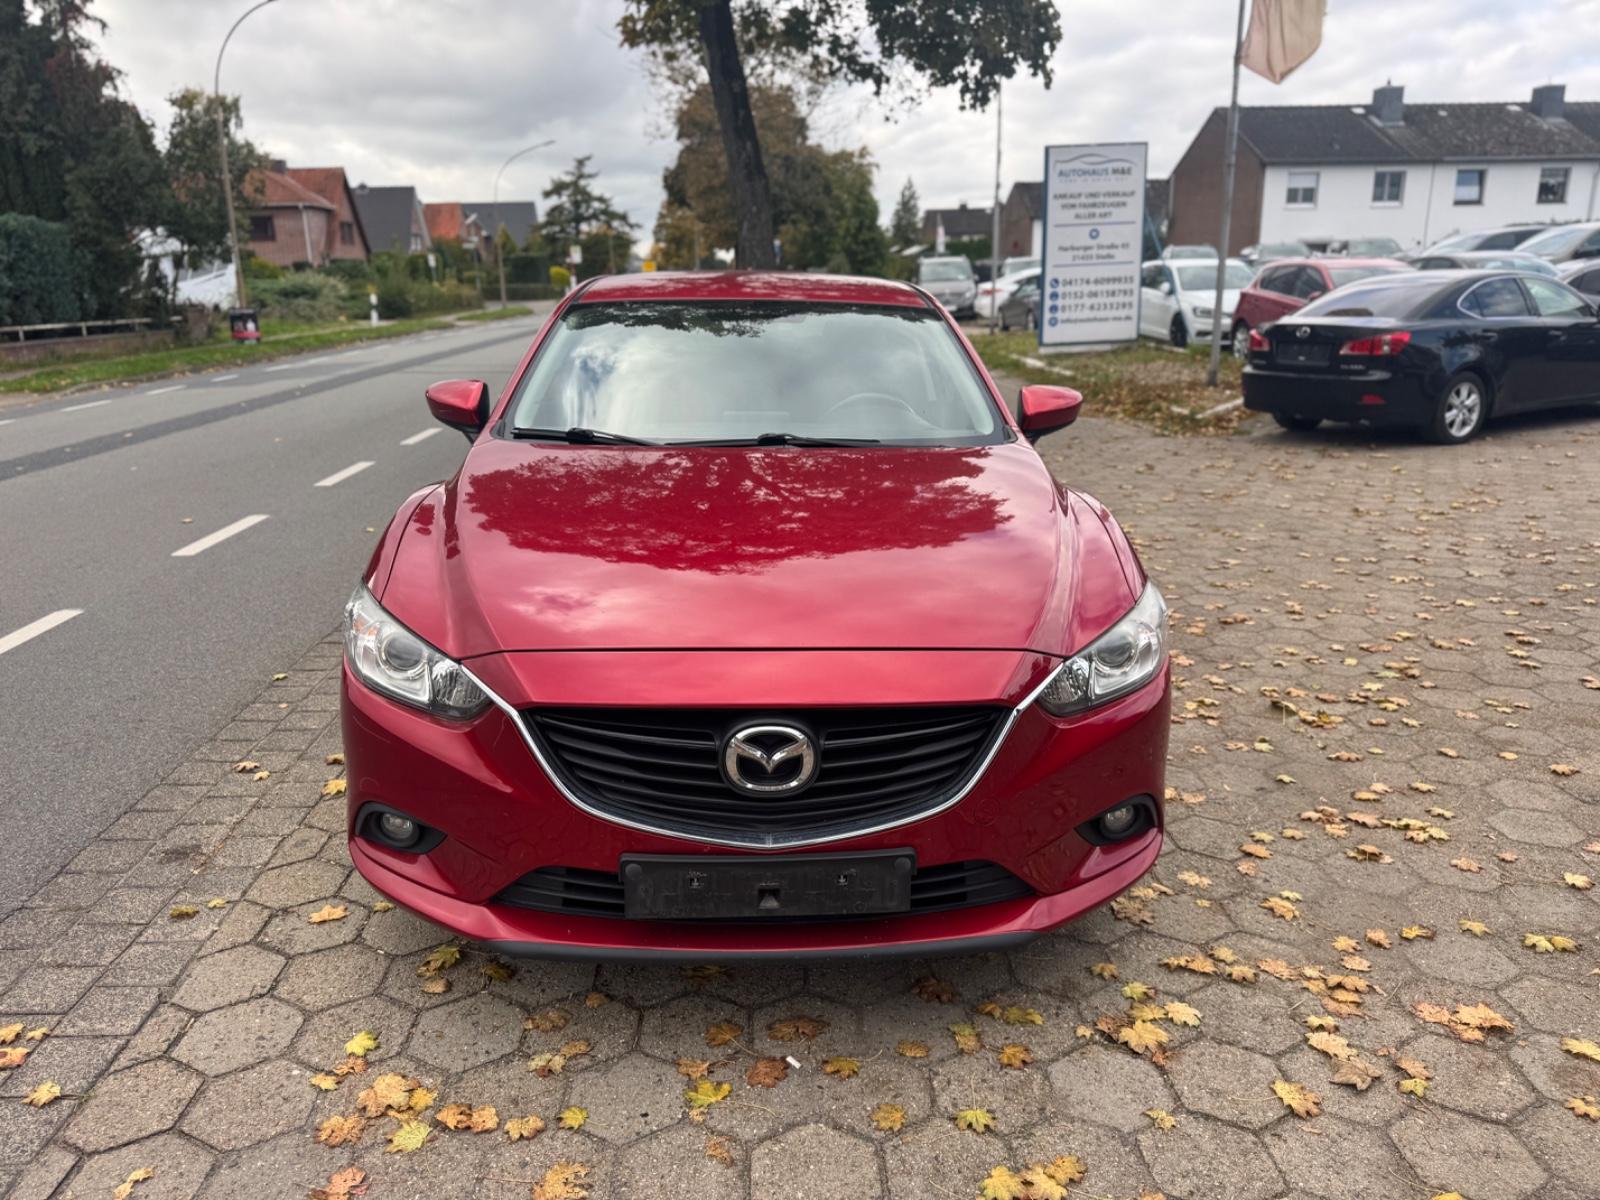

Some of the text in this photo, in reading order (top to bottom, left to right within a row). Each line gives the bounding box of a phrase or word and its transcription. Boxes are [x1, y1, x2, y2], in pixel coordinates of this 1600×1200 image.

[1058, 167, 1132, 178] AUTOHAUS M&E
[1053, 190, 1136, 200] ANKAUF UND VERKAUF
[1079, 201, 1127, 209] FAHRZEUGEN
[1074, 211, 1096, 219] ALLER
